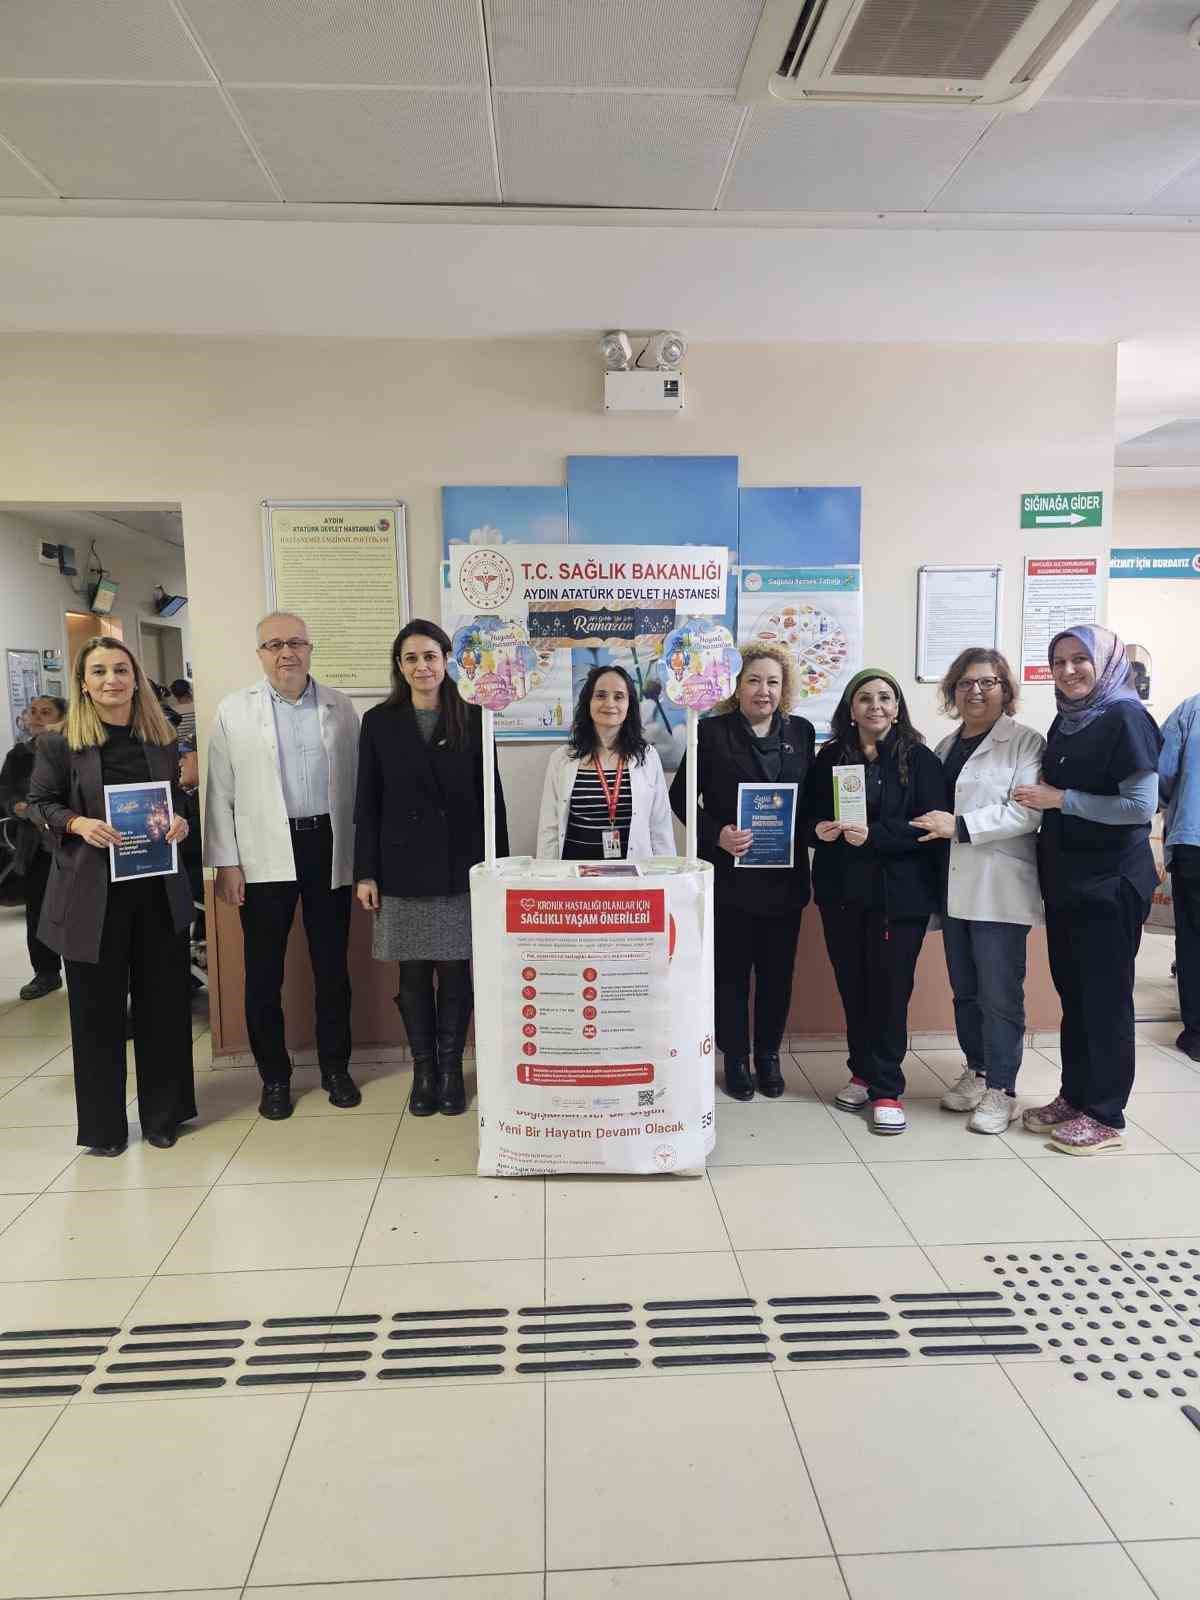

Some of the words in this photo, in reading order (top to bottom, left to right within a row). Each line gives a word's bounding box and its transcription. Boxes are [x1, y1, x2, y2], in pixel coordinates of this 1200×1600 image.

[1024, 494, 1069, 511] SIĞINAĞA
[1070, 494, 1100, 509] GİDER
[521, 563, 553, 580] T.C.
[559, 558, 626, 580] SAĞLIK
[632, 559, 721, 580] BAKANLIĞI
[1136, 555, 1151, 570] İÇİN
[523, 588, 558, 600] AYDIN
[561, 586, 614, 600] ATATÜRK
[617, 588, 661, 600] DEVLET
[663, 586, 720, 600] HASTANESİ
[573, 615, 633, 633] Ramazan
[537, 899, 564, 910] KRONİK
[565, 899, 602, 910] HASTALIĞI
[602, 900, 636, 910] OLANLAR
[636, 898, 650, 911] İÇİN
[520, 911, 563, 925] SAĞLIKLI
[564, 913, 598, 927] YAŞAM
[600, 911, 650, 925] ÖNERİLERİ
[498, 1120, 522, 1135] Yeni
[525, 1126, 541, 1138] Bir
[545, 1127, 592, 1140] Hayatın
[596, 1127, 641, 1138] Devamı
[645, 1121, 685, 1134] Olacak
